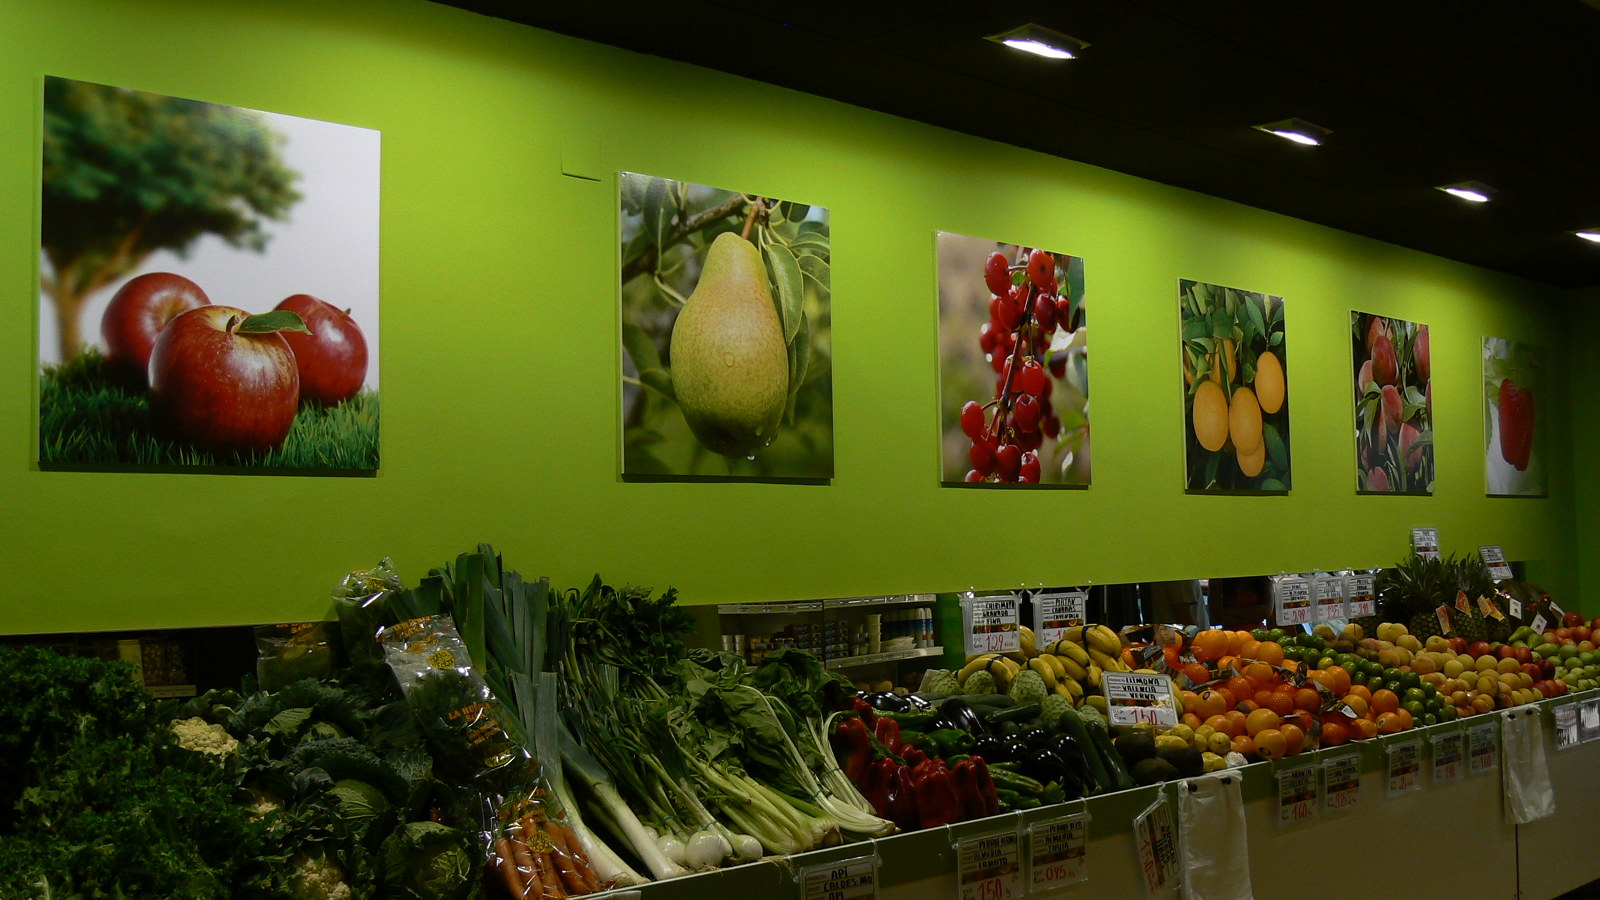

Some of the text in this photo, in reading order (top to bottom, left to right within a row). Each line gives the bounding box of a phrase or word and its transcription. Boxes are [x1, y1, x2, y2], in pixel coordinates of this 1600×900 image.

[986, 617, 1002, 625] FINA
[1122, 685, 1157, 693] VALENCIA
[448, 710, 461, 720] LA
[831, 866, 848, 880] API
[824, 878, 857, 892] CALDES
